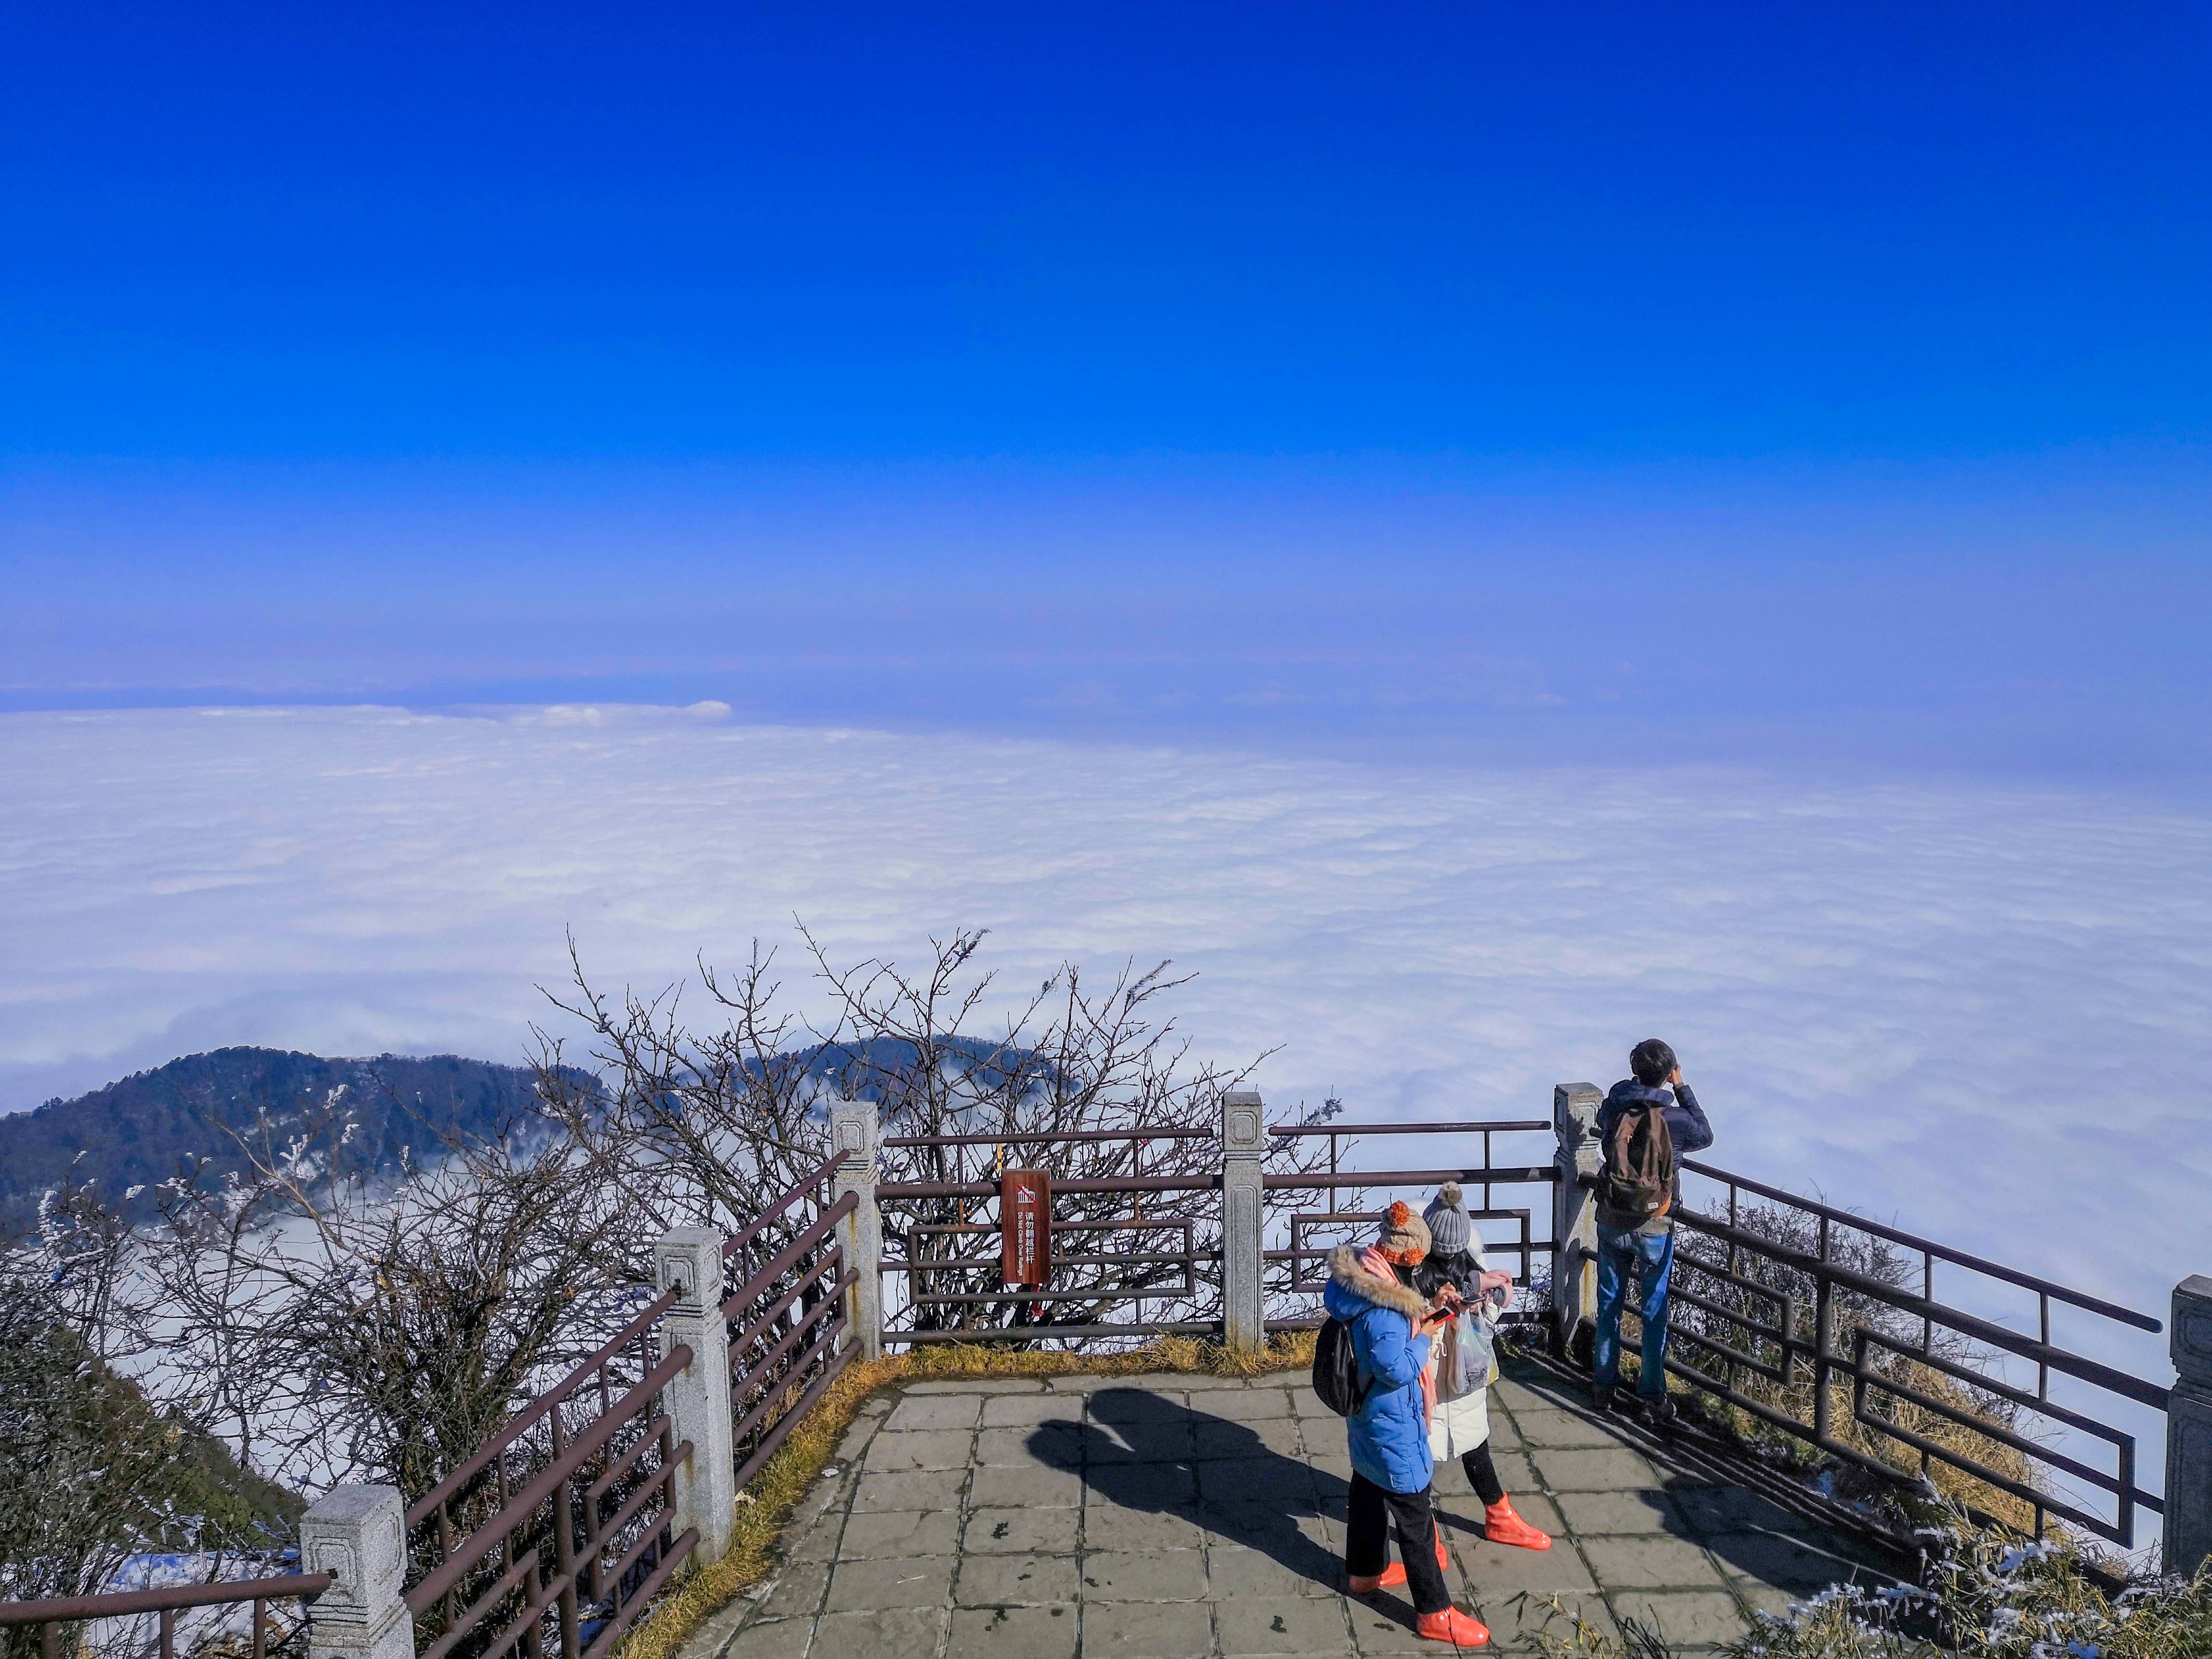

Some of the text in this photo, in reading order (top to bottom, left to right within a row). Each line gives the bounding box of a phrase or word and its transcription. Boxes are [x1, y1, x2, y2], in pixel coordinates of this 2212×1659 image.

[1025, 1212, 1034, 1263] 请勿翻越栏杆
